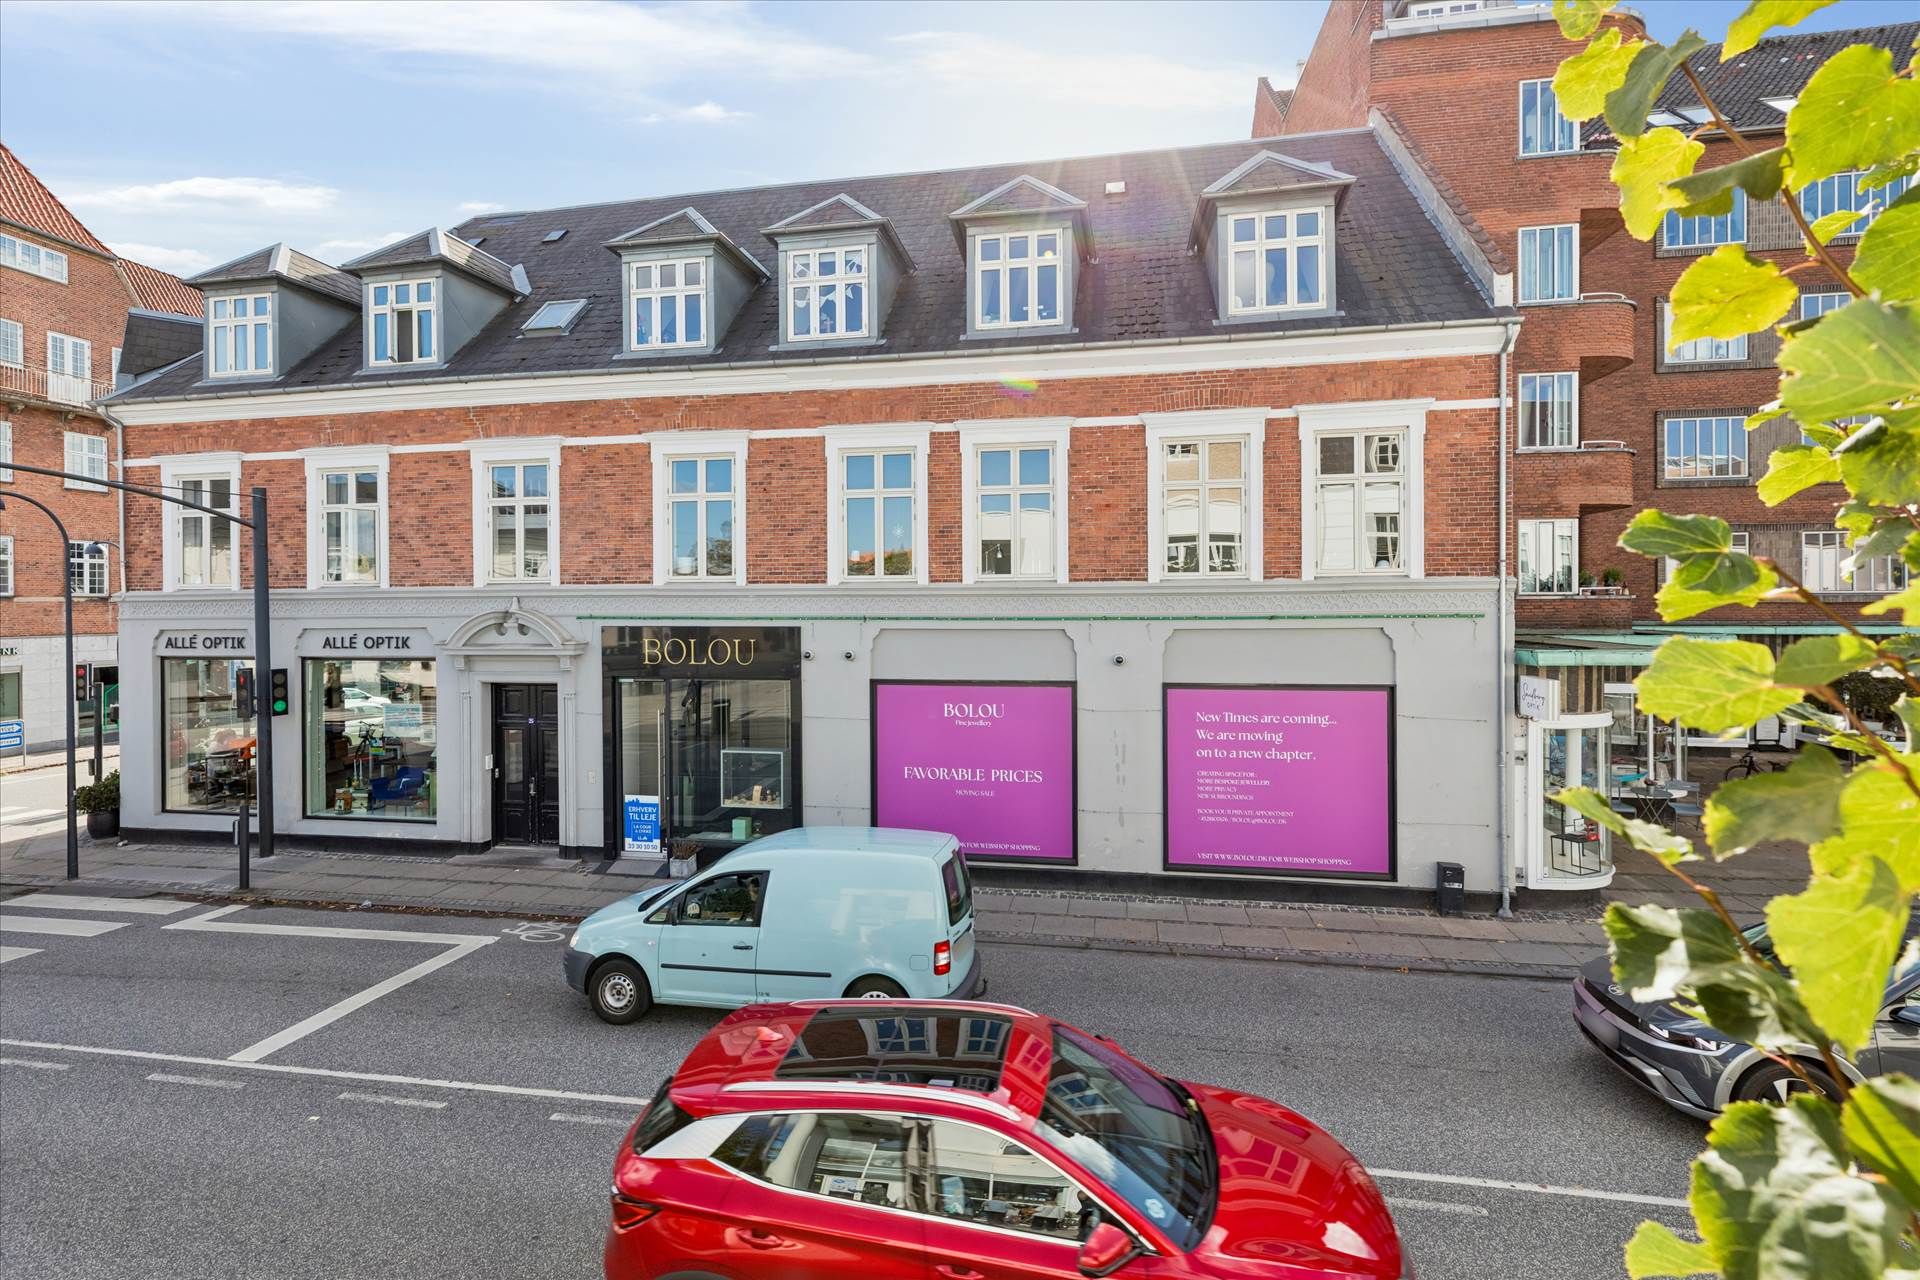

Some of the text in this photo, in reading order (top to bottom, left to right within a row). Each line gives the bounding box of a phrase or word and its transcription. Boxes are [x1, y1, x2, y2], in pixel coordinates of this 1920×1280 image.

[165, 634, 246, 649] ALLÉ OPTIK
[322, 633, 411, 649] ALLÉ OPTIK
[642, 637, 756, 666] BOLOU
[943, 703, 1005, 718] BOLOU
[1196, 711, 1337, 728] New Times are coming...
[1196, 729, 1284, 744] We are moving
[1196, 748, 1316, 763] on to a new chapter.
[904, 766, 1043, 783] FAVORABLE PRICES
[955, 789, 979, 797] MOVING
[629, 813, 657, 821] TIL LEJE
